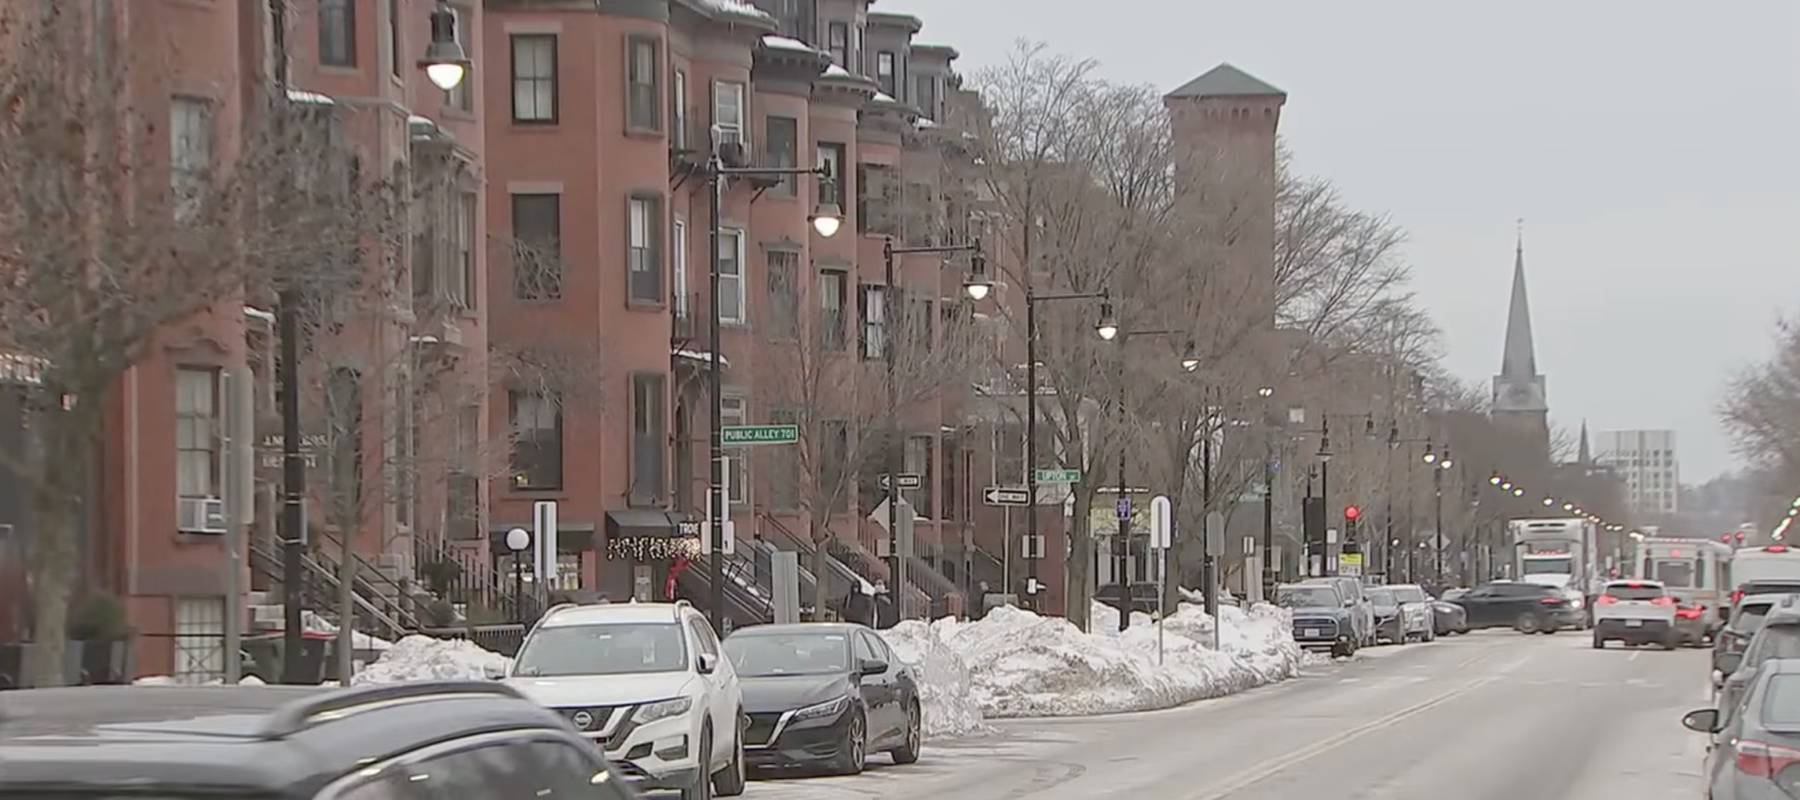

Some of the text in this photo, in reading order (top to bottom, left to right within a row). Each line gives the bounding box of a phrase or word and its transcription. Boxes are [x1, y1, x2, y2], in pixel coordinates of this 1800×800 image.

[725, 429, 795, 440] PUBLIC ALLEY 701
